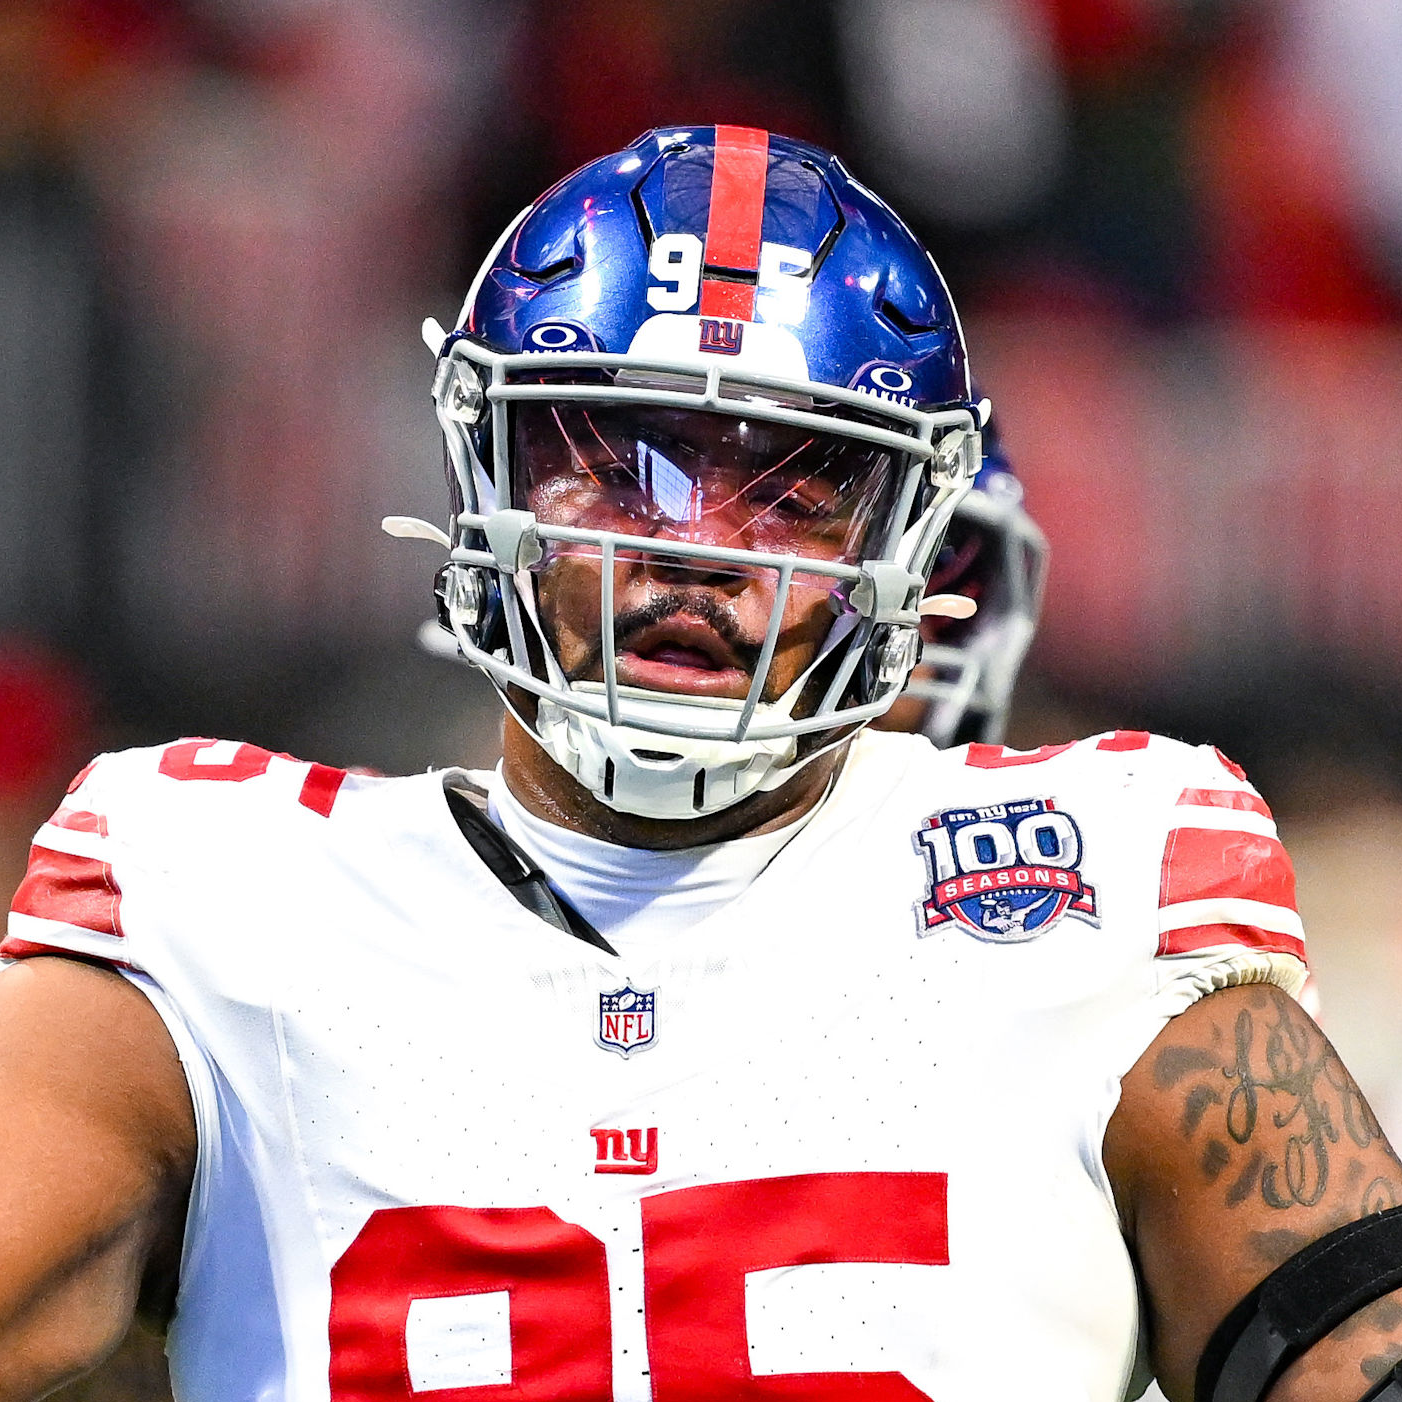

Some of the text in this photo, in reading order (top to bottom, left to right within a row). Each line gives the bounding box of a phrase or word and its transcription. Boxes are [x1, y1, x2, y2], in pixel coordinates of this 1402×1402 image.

[922, 811, 1078, 881] 100
[944, 869, 1070, 898] SEASONS
[605, 1014, 649, 1043] NFL
